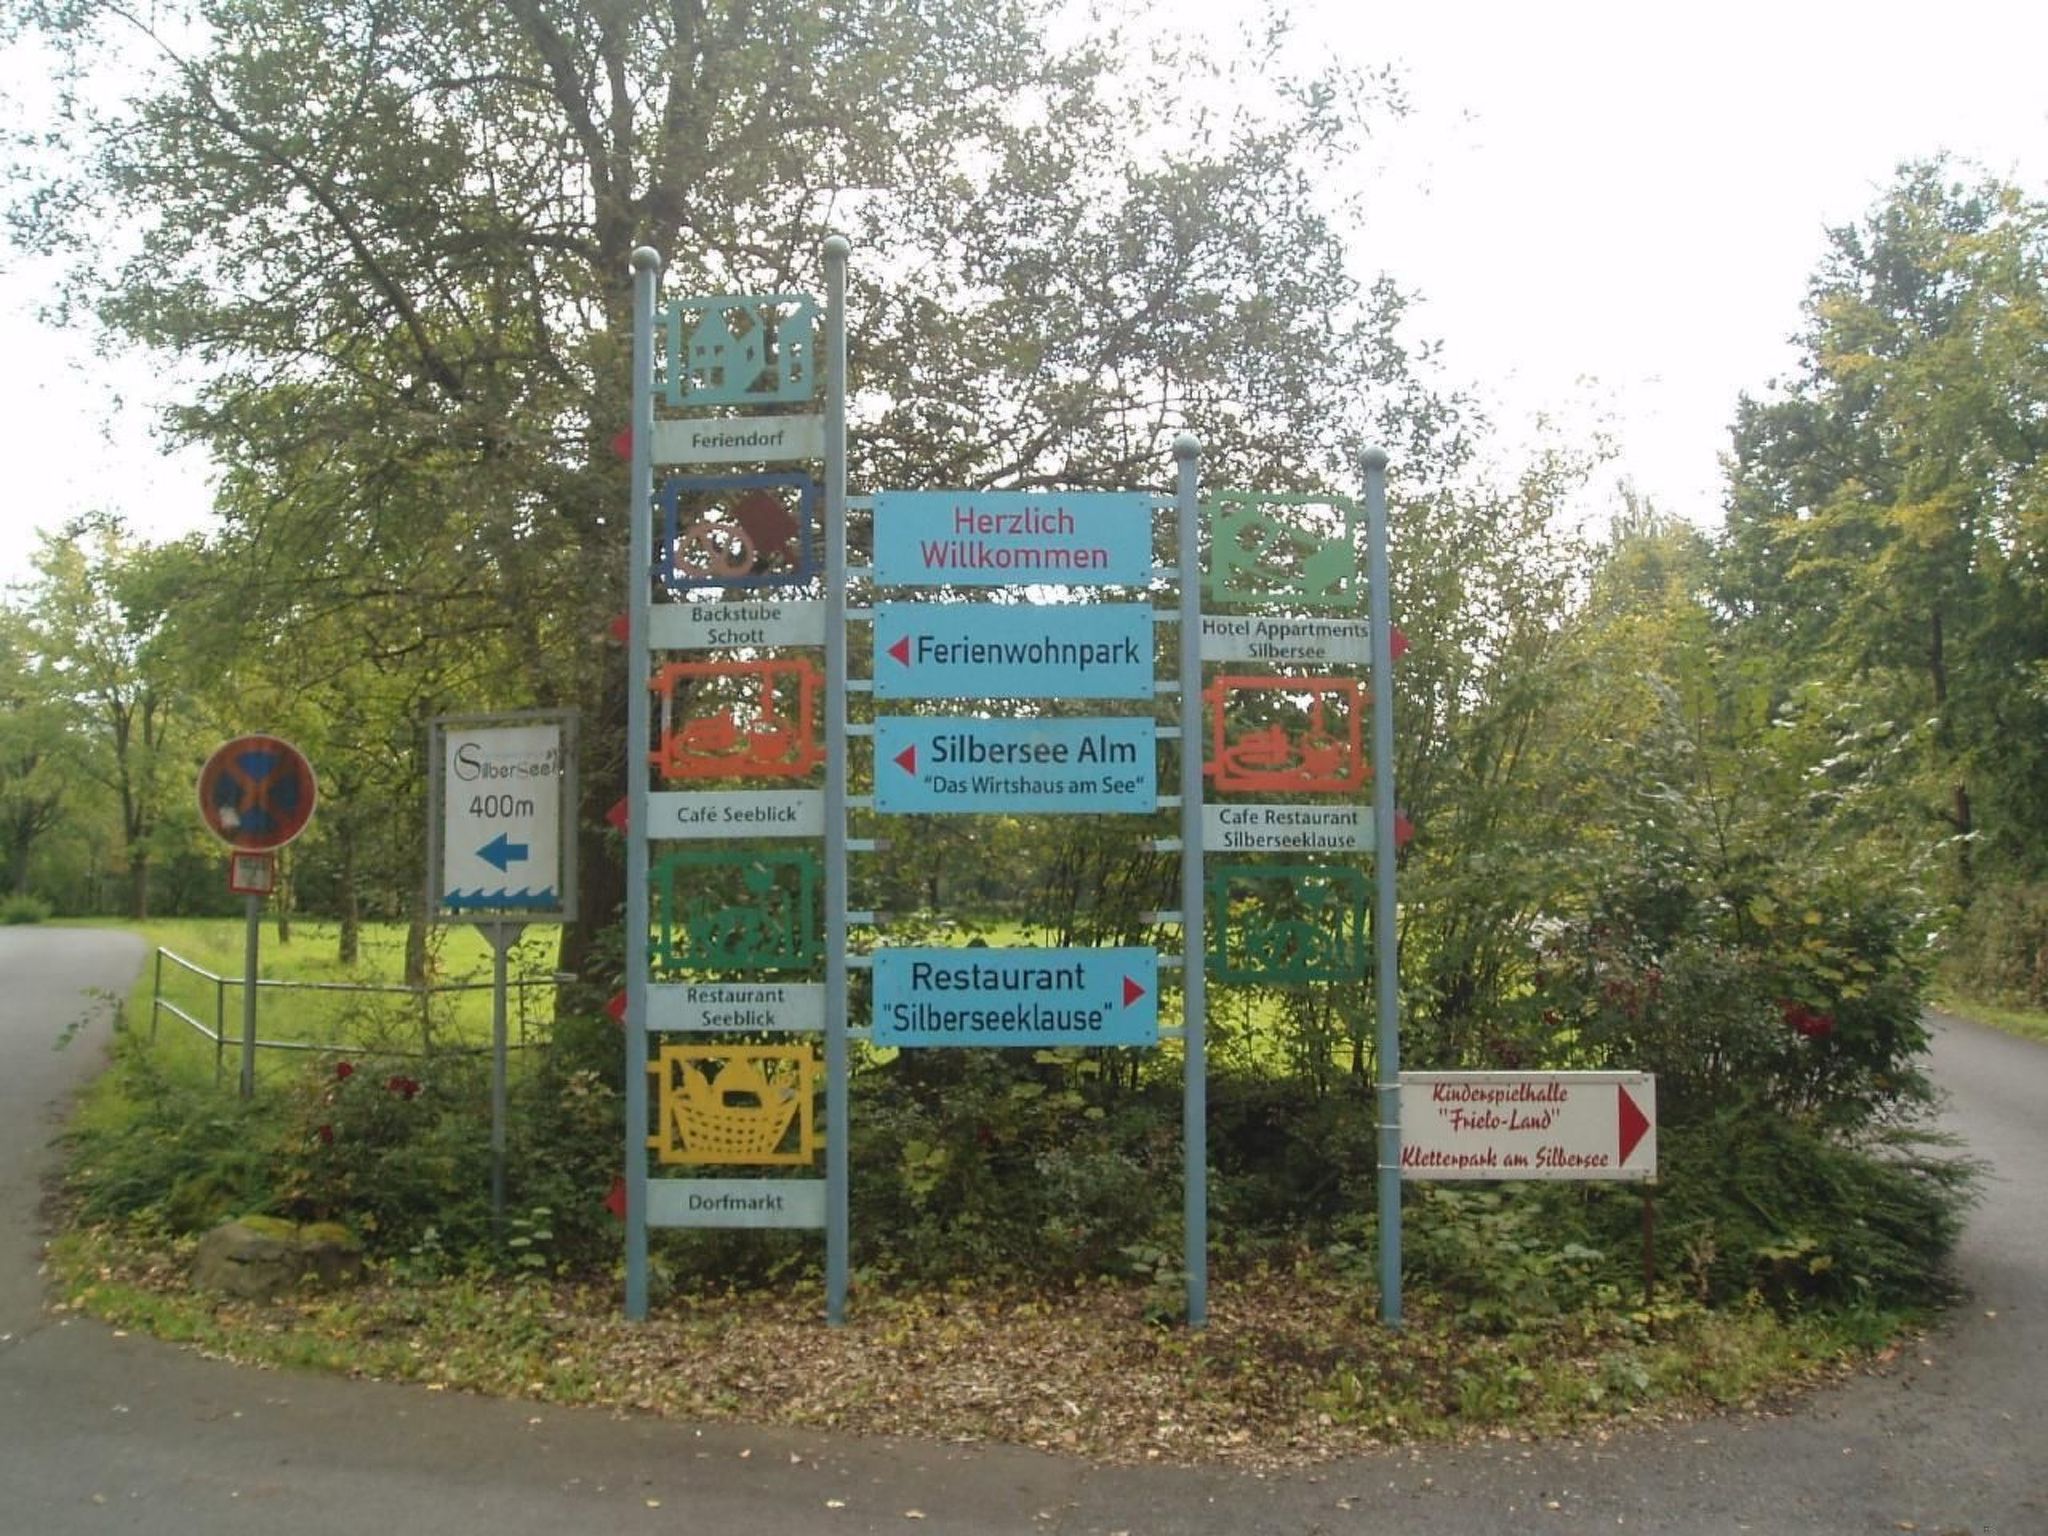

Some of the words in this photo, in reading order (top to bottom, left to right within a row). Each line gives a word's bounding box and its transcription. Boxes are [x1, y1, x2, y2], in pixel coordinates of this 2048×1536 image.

[692, 431, 784, 448] Feriendorf
[954, 507, 1075, 535] Herzlich
[920, 540, 1109, 569] Willkommen
[691, 606, 782, 623] Backstube
[707, 629, 764, 644] Schott
[1202, 620, 1249, 635] Hotel
[1256, 621, 1368, 640] Appartments
[918, 635, 1140, 671] Ferienwohnpark
[1248, 643, 1325, 658] Silbersee
[931, 735, 1069, 764] Silbersee
[1076, 736, 1136, 763] Alm
[972, 776, 1064, 794] Wirtshaus
[1068, 780, 1097, 794] am
[469, 794, 534, 818] 400m
[677, 806, 717, 822] Café
[723, 806, 797, 822] Seeblick
[1219, 809, 1258, 825] Cafe
[1265, 809, 1358, 825] Restaurant
[1223, 831, 1356, 848] Silberseeklause
[912, 962, 1085, 990] Restaurant
[687, 987, 784, 1003] Restaurant
[702, 1010, 775, 1026] Seeblick
[883, 1002, 1113, 1032] "Silberseeklause"
[1433, 1082, 1568, 1104] Kinderspielhalle
[1402, 1146, 1497, 1168] Kletterpark
[1503, 1157, 1528, 1168] am
[1535, 1146, 1609, 1168] Silbersee
[688, 1193, 783, 1210] Dorfmarkt
